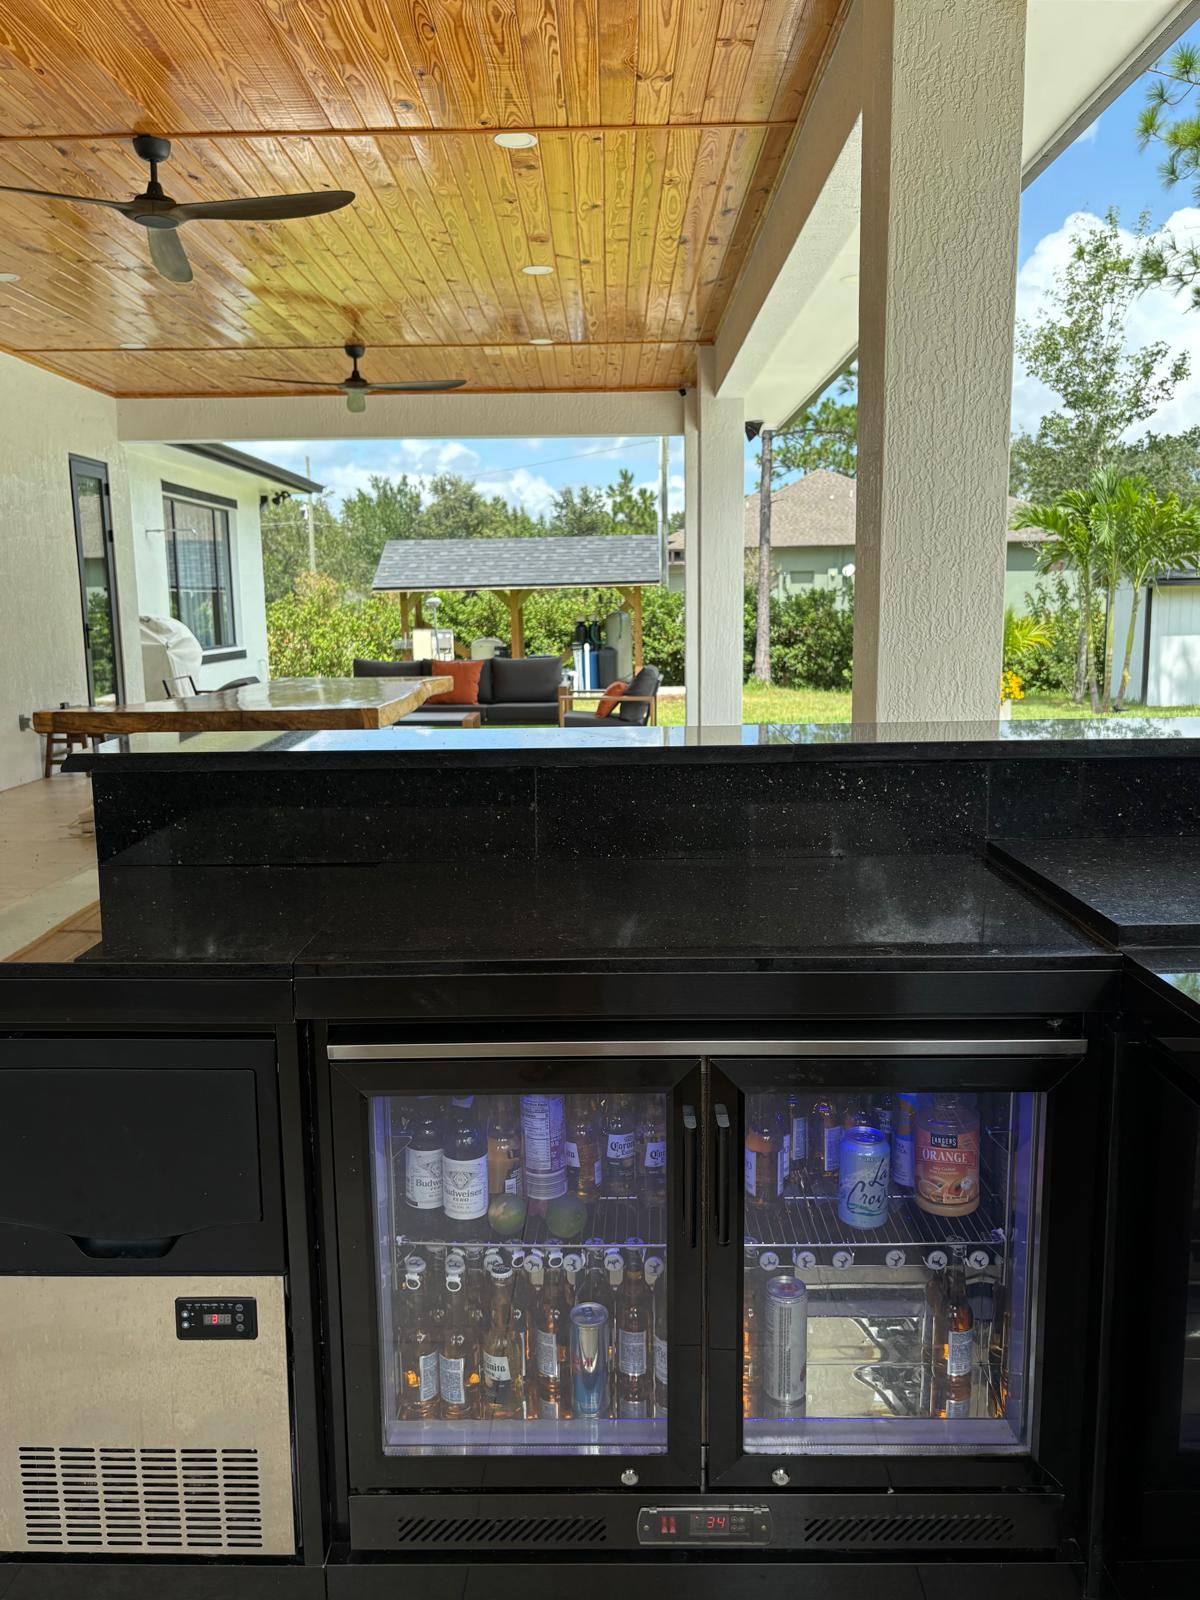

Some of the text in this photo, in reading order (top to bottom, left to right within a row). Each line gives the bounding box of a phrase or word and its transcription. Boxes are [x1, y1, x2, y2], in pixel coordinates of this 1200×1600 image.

[931, 1136, 957, 1146] LANGERS
[922, 1148, 968, 1163] ORANGE
[706, 1516, 725, 1529] 34
